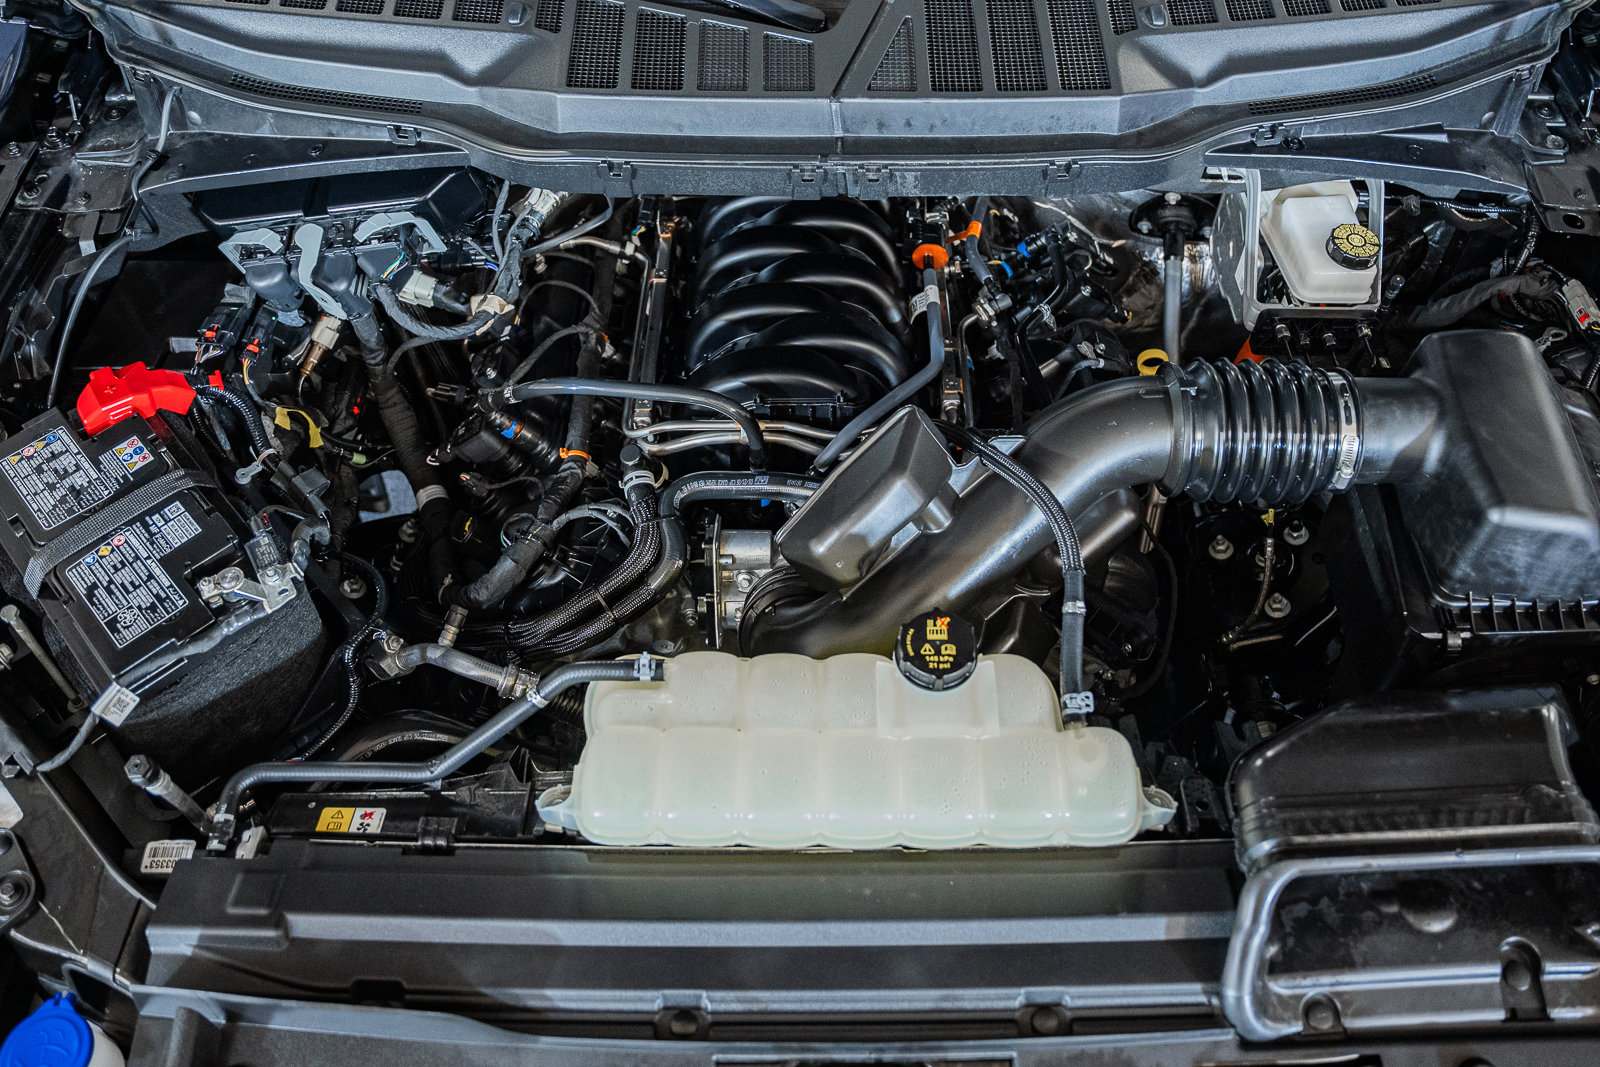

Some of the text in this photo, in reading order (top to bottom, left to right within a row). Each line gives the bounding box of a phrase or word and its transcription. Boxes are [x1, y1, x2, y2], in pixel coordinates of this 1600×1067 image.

[154, 516, 162, 524] 12V
[148, 523, 160, 535] MF
[155, 534, 171, 553] FoMoCo
[939, 662, 951, 670] psi
